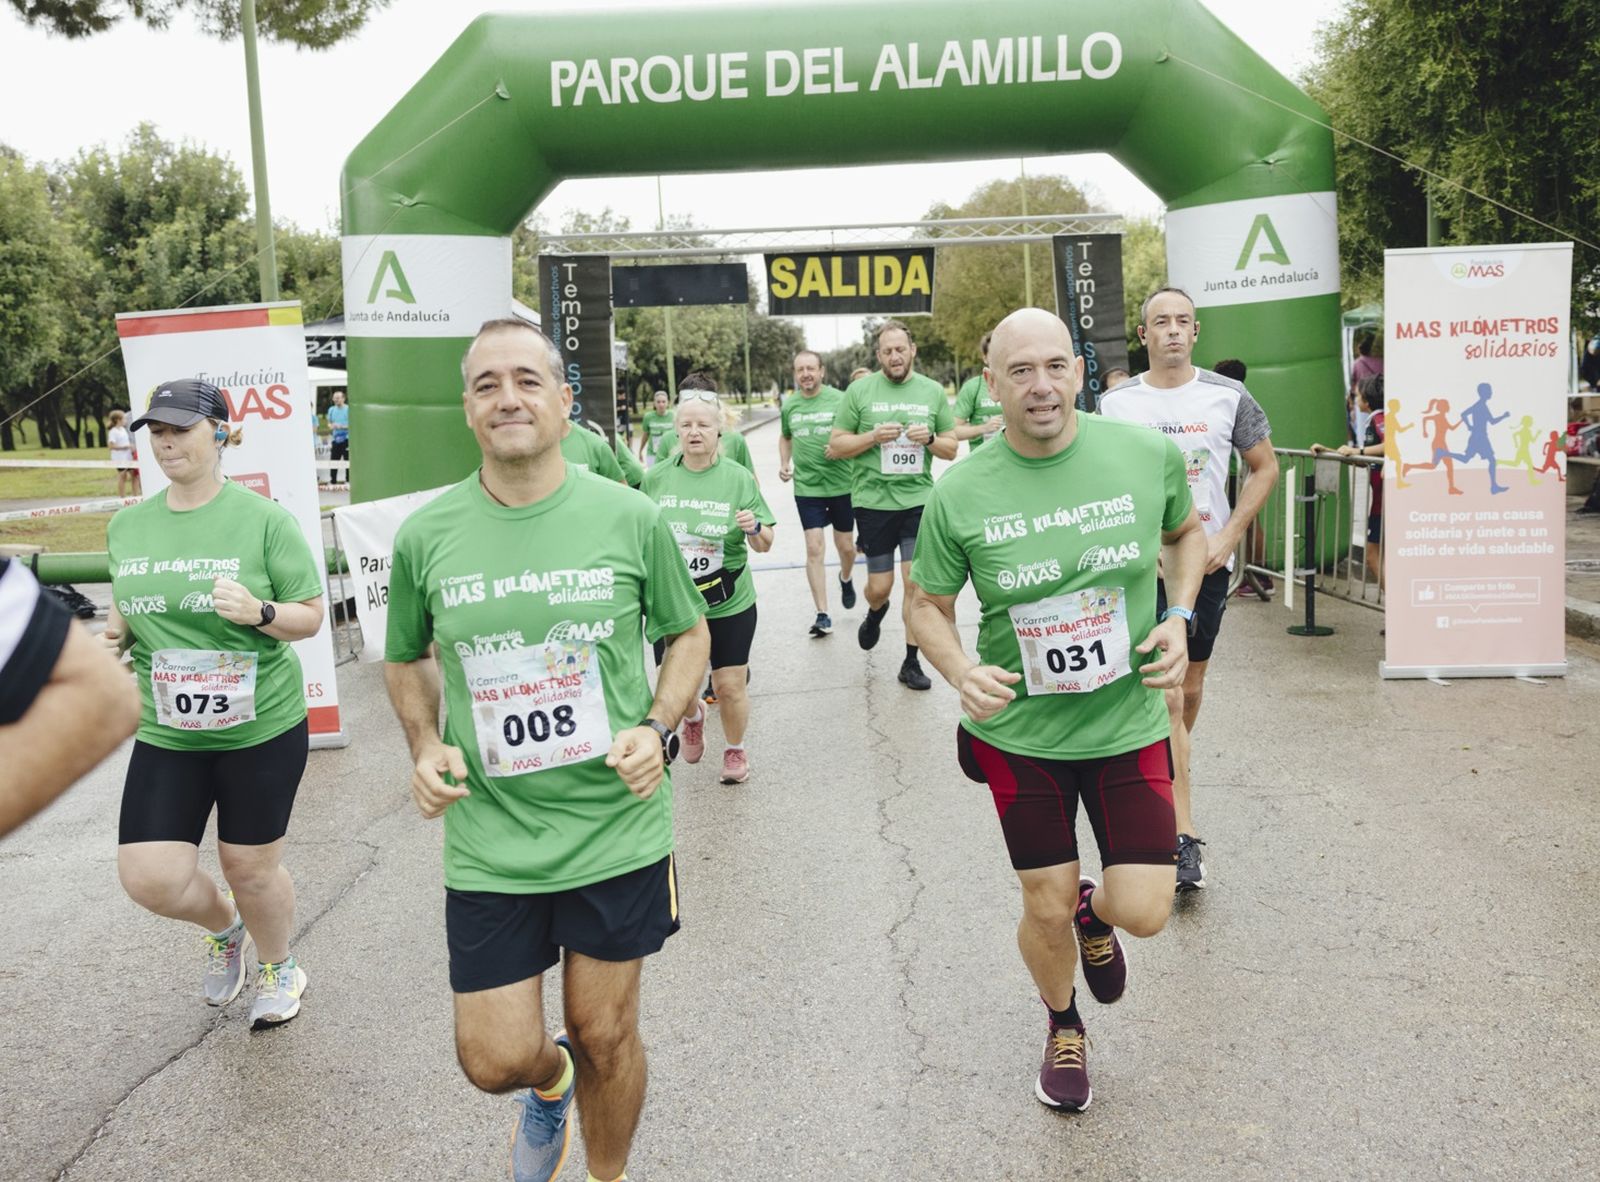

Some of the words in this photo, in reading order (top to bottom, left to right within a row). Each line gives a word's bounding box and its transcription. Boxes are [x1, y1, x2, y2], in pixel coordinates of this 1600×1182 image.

[551, 52, 748, 107] PARQUE
[766, 47, 859, 97] DEL
[869, 31, 1123, 91] ALAMILLO
[770, 254, 931, 299] SALIDA
[1065, 245, 1074, 299] deportivos
[1467, 265, 1504, 278] MAS
[1076, 242, 1095, 329] Tempo
[1203, 280, 1237, 292] Junta
[1241, 276, 1257, 288] de
[1260, 268, 1319, 286] Andalucía
[551, 265, 560, 320] deportivos
[561, 263, 582, 351] Tempo
[349, 311, 369, 322] Junta
[371, 311, 384, 322] de
[387, 309, 450, 322] Andalucía
[1396, 321, 1441, 339] MAS
[1450, 316, 1559, 337] KILÓMETROS
[1465, 337, 1559, 360] solidarios
[893, 453, 916, 465] 090
[48, 506, 81, 516] PASAR
[123, 499, 138, 507] NO
[984, 519, 1028, 544] MAS
[1032, 494, 1135, 533] KILÓMETROS
[991, 512, 1023, 524] Carrera
[1079, 512, 1136, 535] solidarios
[1409, 511, 1447, 523] Corre
[1449, 511, 1472, 524] por
[1475, 511, 1499, 521] una
[1503, 509, 1545, 521] causa
[1405, 528, 1463, 540] solidaria
[1466, 529, 1473, 541] y
[1477, 526, 1516, 538] únete
[1518, 528, 1527, 537] a
[1530, 527, 1549, 537] un
[1096, 541, 1141, 565] MAS
[1398, 545, 1436, 557] estilo
[1438, 544, 1456, 555] de
[1458, 543, 1487, 555] vida
[1488, 542, 1555, 555] saludable
[118, 561, 149, 578] MAS
[153, 557, 240, 574] KILÓMETROS
[1016, 556, 1059, 572] Fundación
[449, 573, 484, 585] Carrera
[1016, 564, 1062, 589] MAS
[441, 580, 487, 609] MAS
[493, 568, 616, 598] KILÓMETROS
[547, 587, 615, 606] solidarios
[131, 600, 168, 616] MAS
[1014, 617, 1021, 625] V
[1022, 614, 1059, 626] Carrera
[472, 629, 523, 645] Fundación
[568, 619, 616, 643] MAS
[1017, 627, 1042, 638] MAS
[1046, 640, 1107, 674] 031
[162, 662, 196, 672] Carrera
[153, 671, 177, 683] MAS
[476, 673, 518, 687] Carrera
[1056, 682, 1082, 692] MAS
[175, 693, 230, 714] 073
[473, 689, 499, 702] MAS
[533, 689, 583, 706] solidarios
[180, 721, 202, 729] MAS
[503, 704, 577, 747] 008
[563, 742, 592, 759] MAS
[512, 757, 543, 772] MAS
